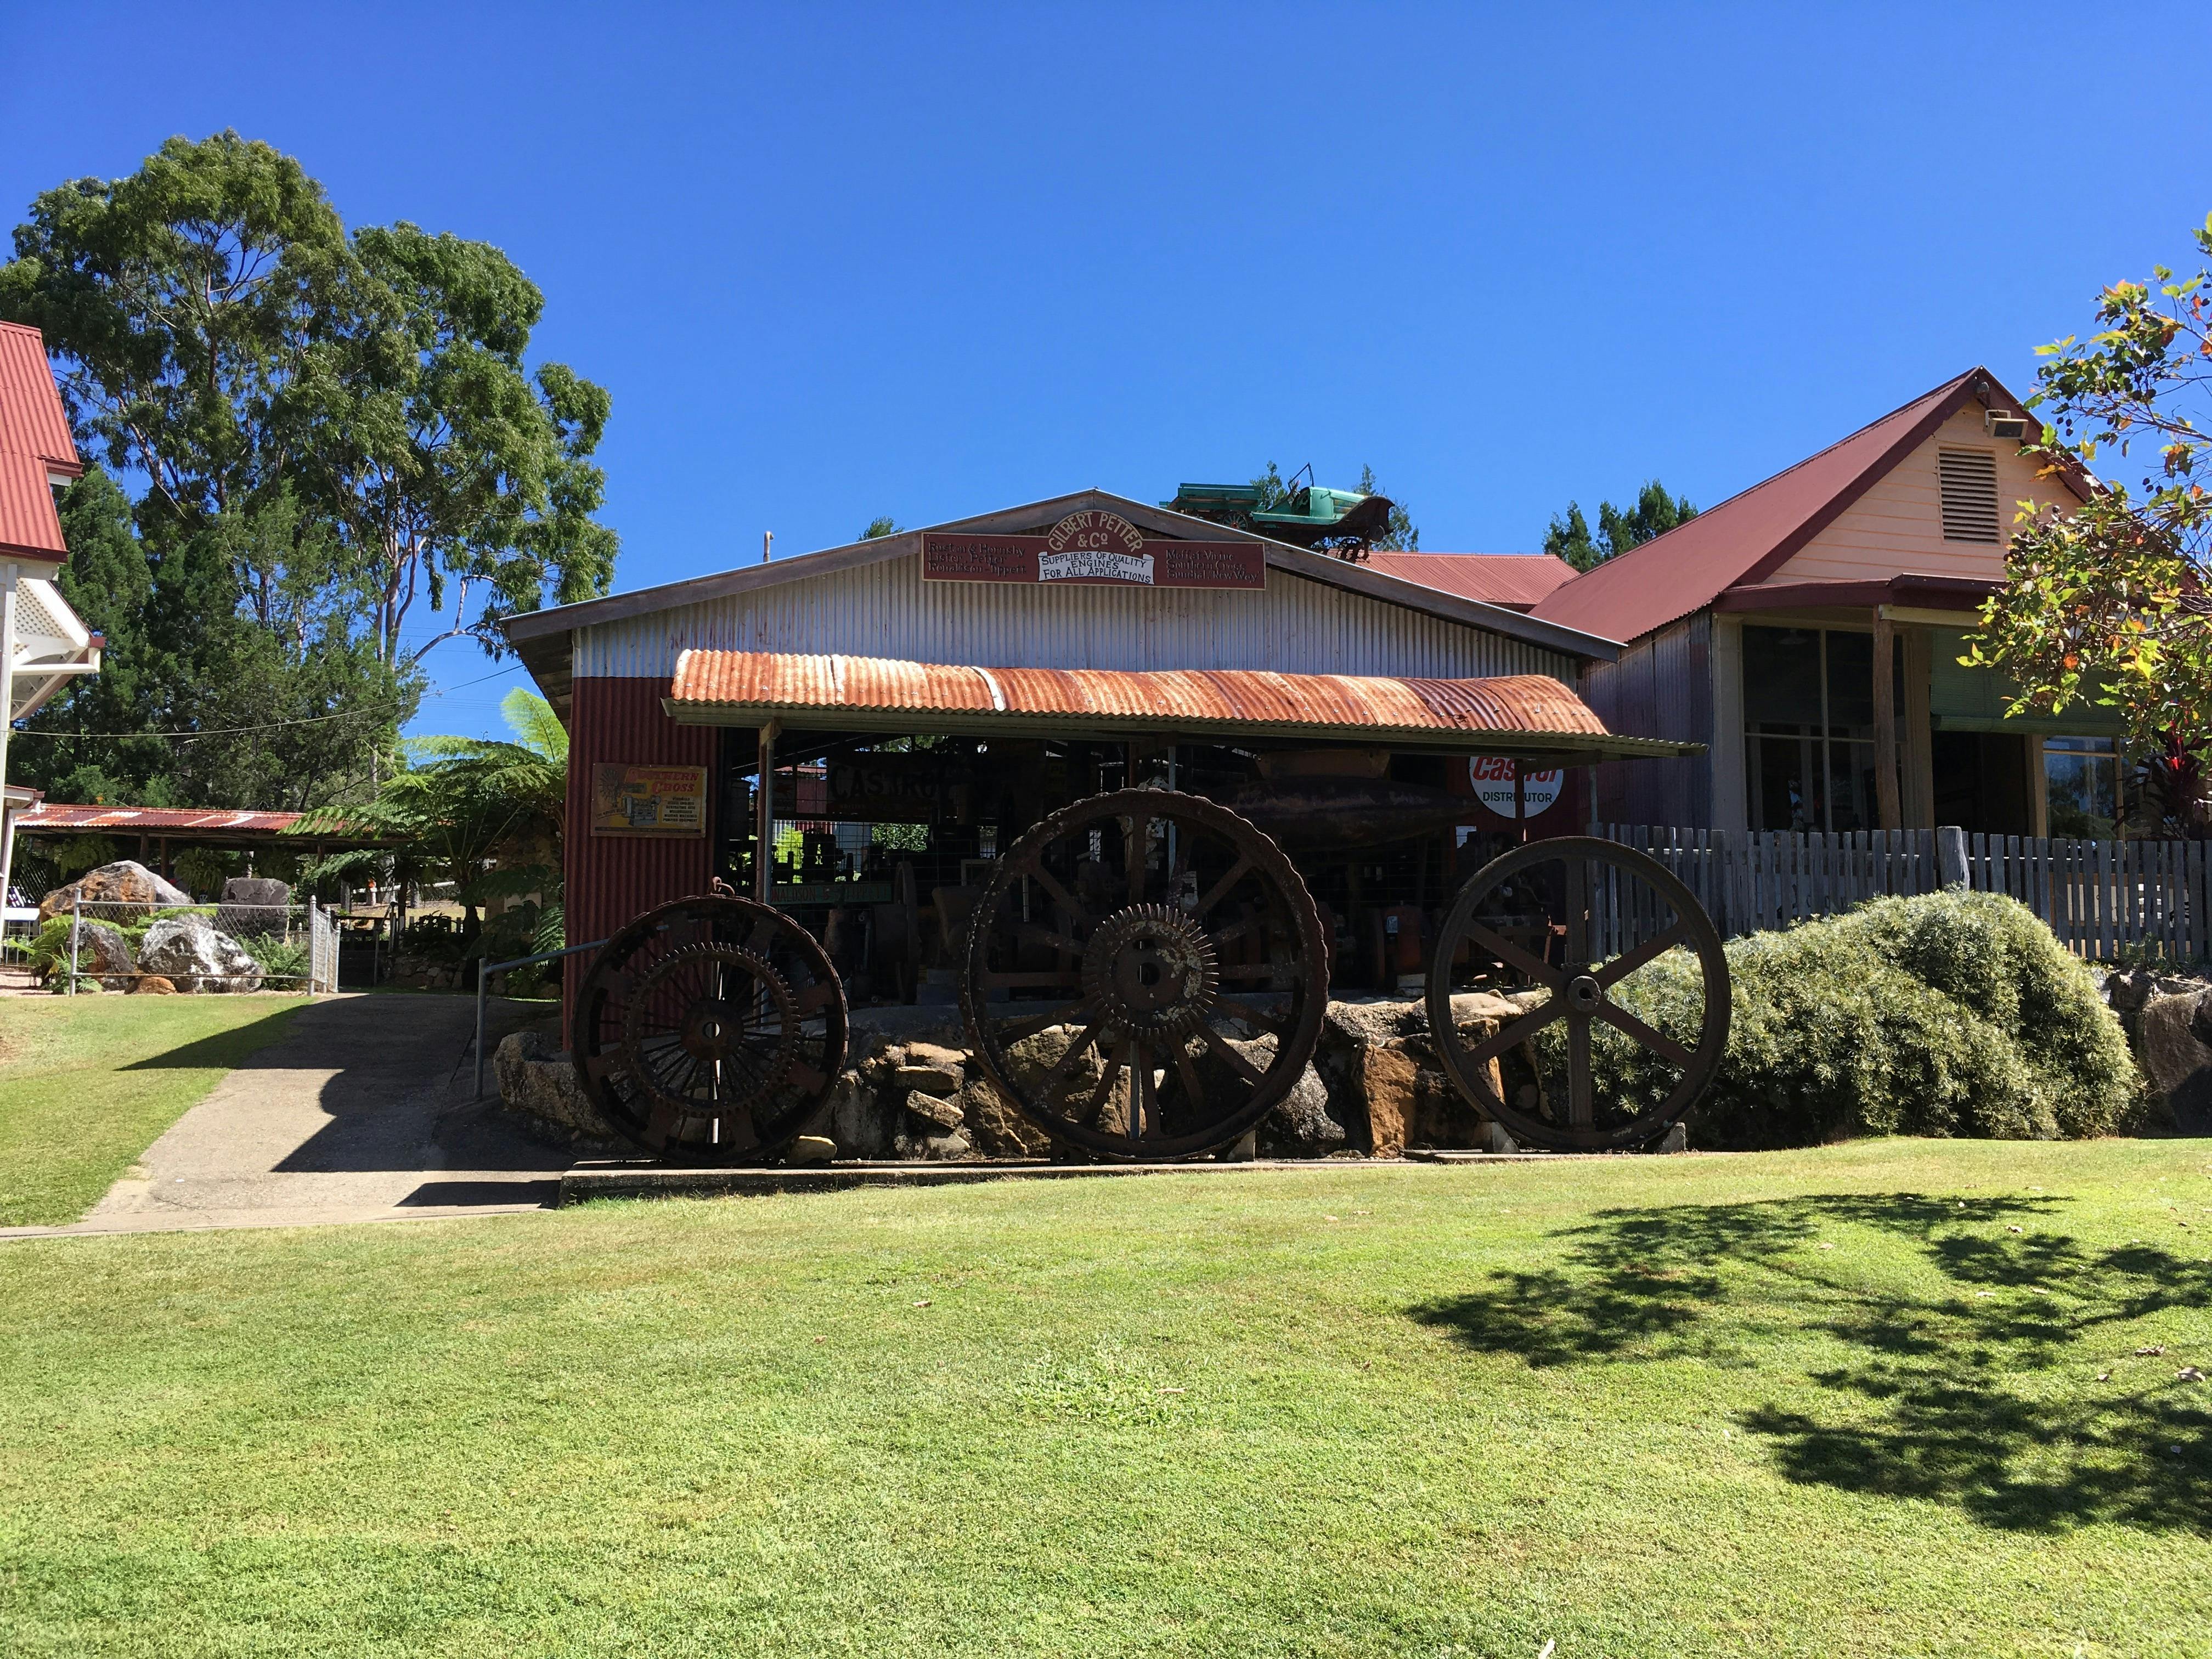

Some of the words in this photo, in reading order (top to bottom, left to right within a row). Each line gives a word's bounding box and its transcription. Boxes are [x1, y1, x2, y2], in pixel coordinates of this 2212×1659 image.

[1048, 512, 1093, 551] GILBERT
[1099, 512, 1143, 552] PETTER
[1077, 534, 1087, 548] &
[928, 542, 966, 554] Ruston
[968, 544, 977, 553] &
[979, 543, 1025, 558] Hornsby
[969, 552, 1007, 564] Petter
[1041, 552, 1092, 565] SUPPLIERS
[1109, 552, 1147, 568] QUALITY
[1071, 560, 1119, 569] ENGINES
[1166, 559, 1212, 571] Southern
[1216, 561, 1246, 572] Cross
[1043, 569, 1062, 579] FOR
[1066, 567, 1084, 577] ALL
[1087, 567, 1151, 583] APPLICATIONS
[1473, 757, 1557, 782] Caso
[652, 781, 695, 794] CROSS
[830, 763, 936, 798] CASTRO
[1483, 792, 1552, 803] DISTRIUTOR
[771, 886, 816, 902] ONALDSON
